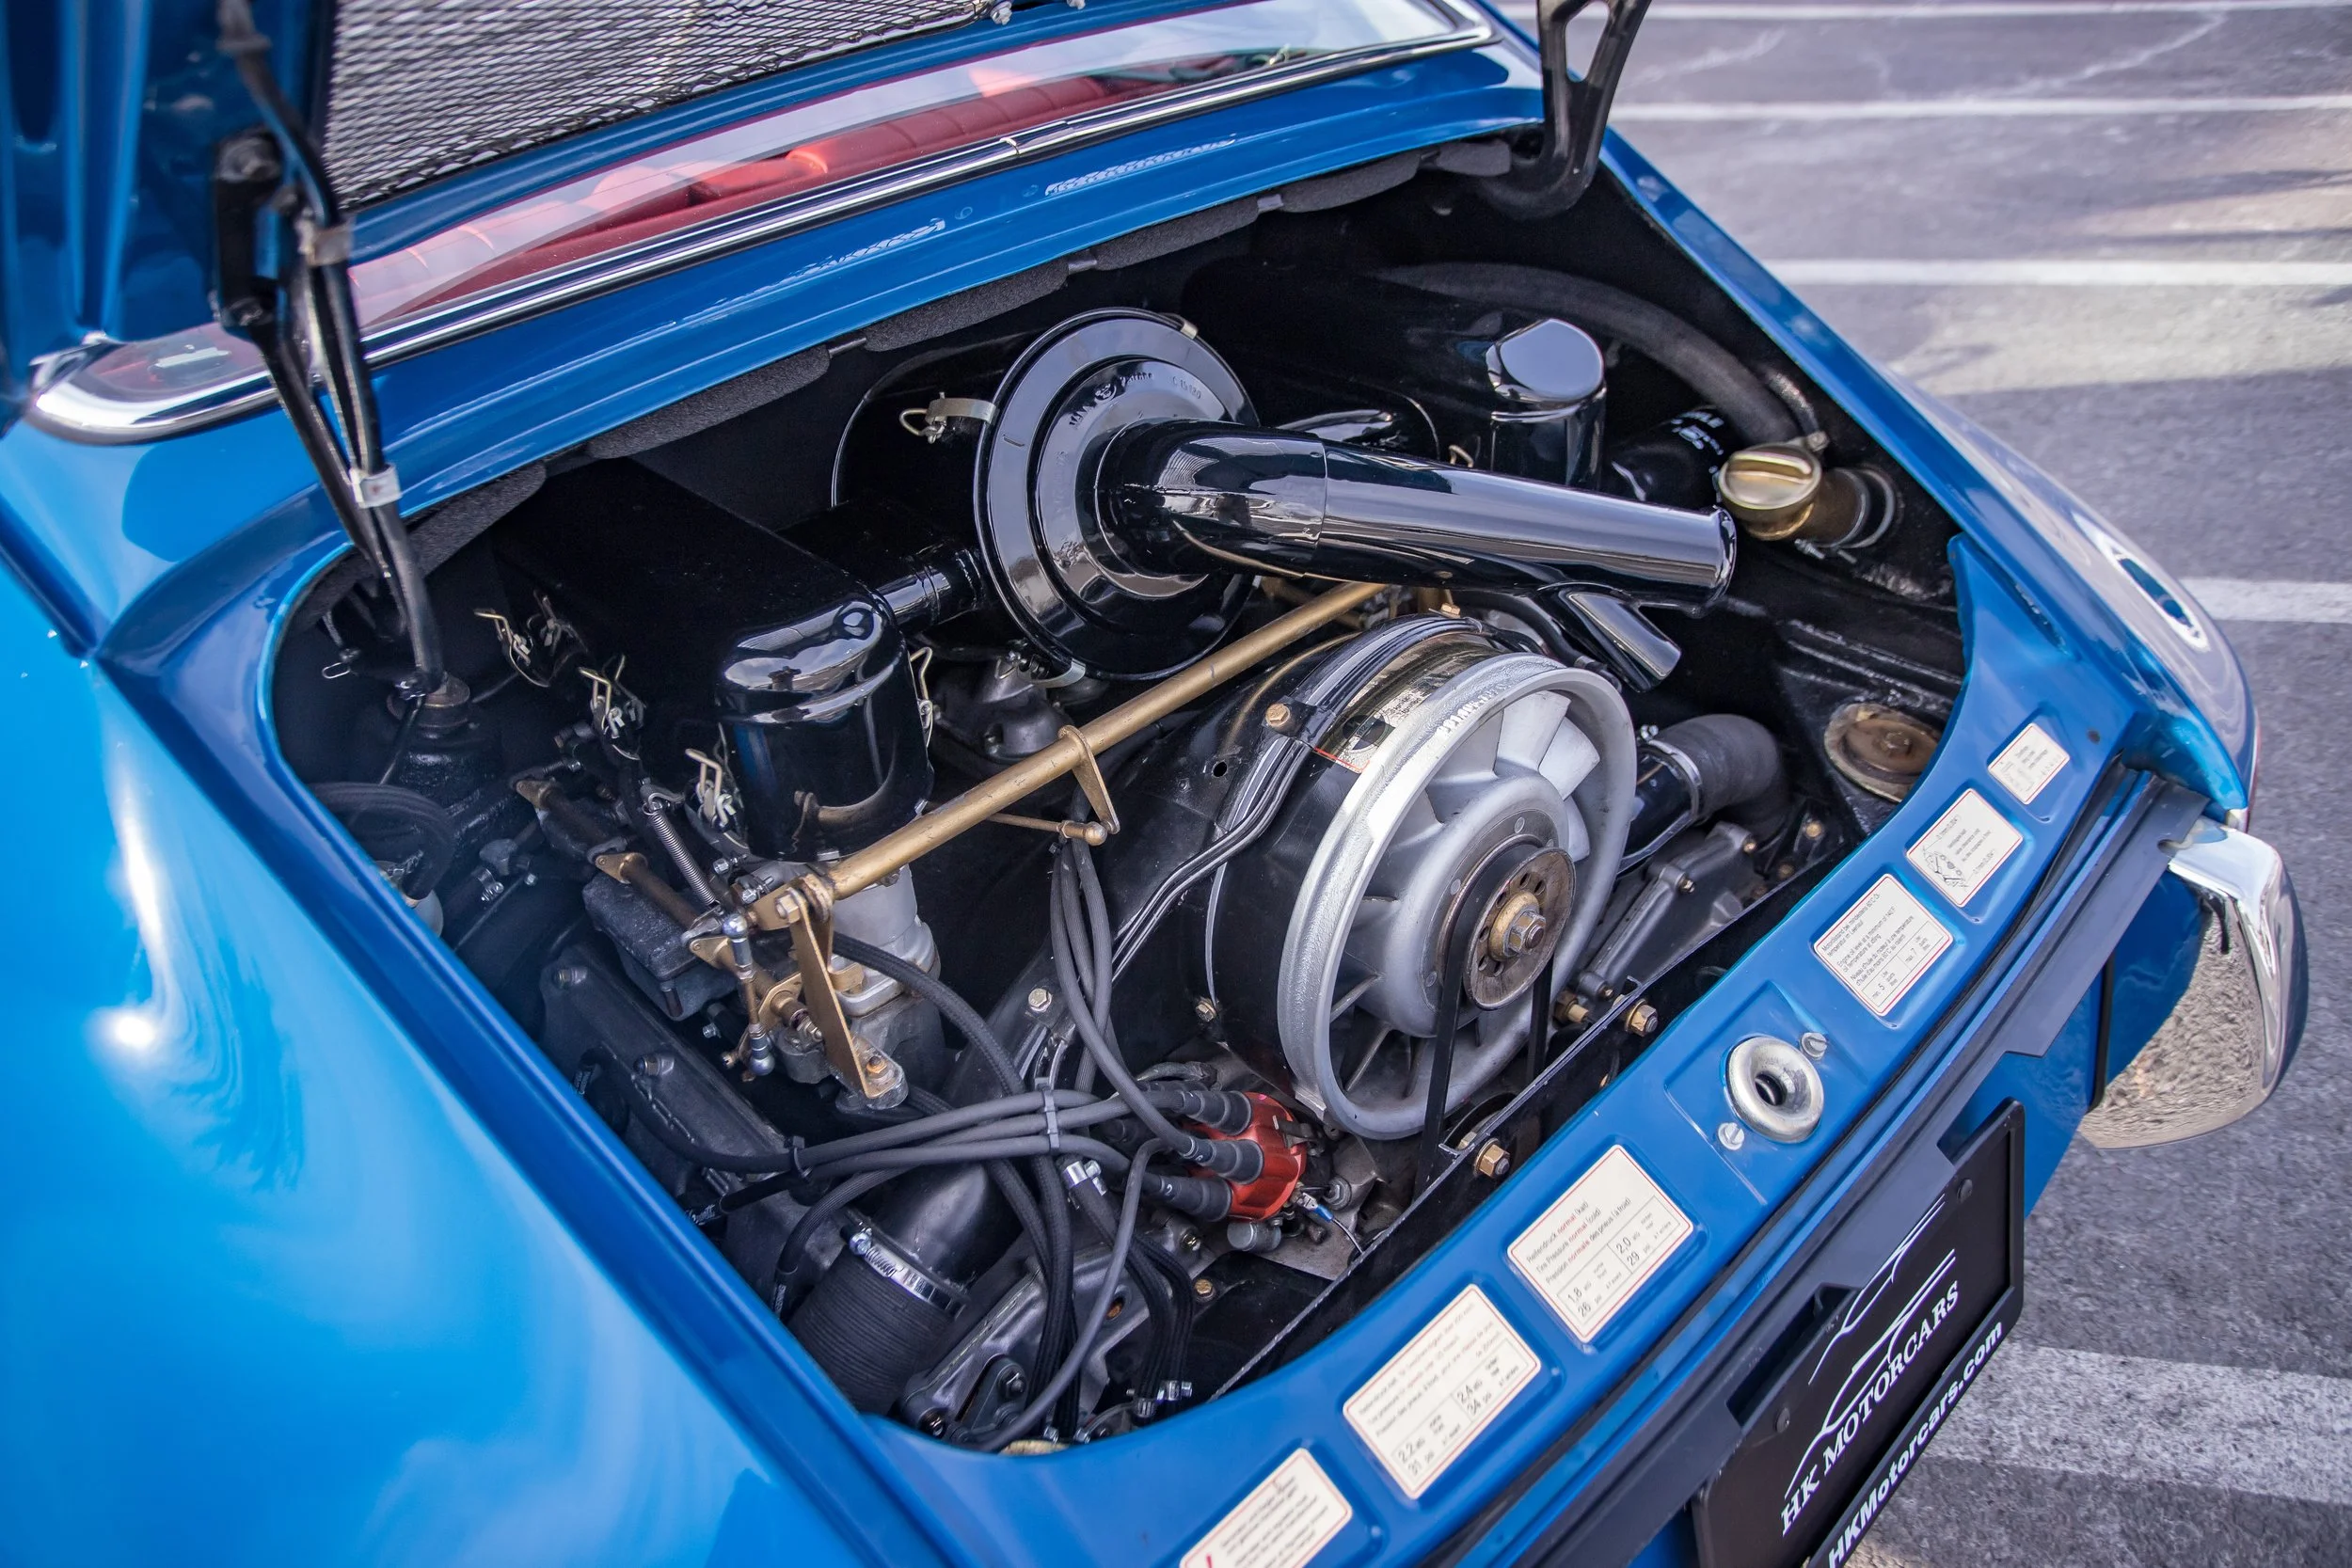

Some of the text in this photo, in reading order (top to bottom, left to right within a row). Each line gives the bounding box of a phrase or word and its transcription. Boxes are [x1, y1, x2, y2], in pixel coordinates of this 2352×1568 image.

[1836, 952, 1851, 968] Engine
[1852, 940, 1863, 950] level
[1846, 945, 1868, 969] temperature
[1877, 982, 1885, 991] 5
[1554, 1212, 1577, 1235] normal
[1544, 1238, 1570, 1264] Pressure
[1565, 1220, 1588, 1243] normal
[1614, 1235, 1633, 1256] 2,0
[1544, 1259, 1568, 1285] Pression
[1565, 1237, 1591, 1264] normale
[1625, 1249, 1641, 1267] 29
[1565, 1285, 1584, 1307] 1,8
[1576, 1299, 1593, 1318] 26
[1780, 1279, 1960, 1538] HK MOTORCARS
[1828, 1319, 2004, 1568] HKMotorcars.com
